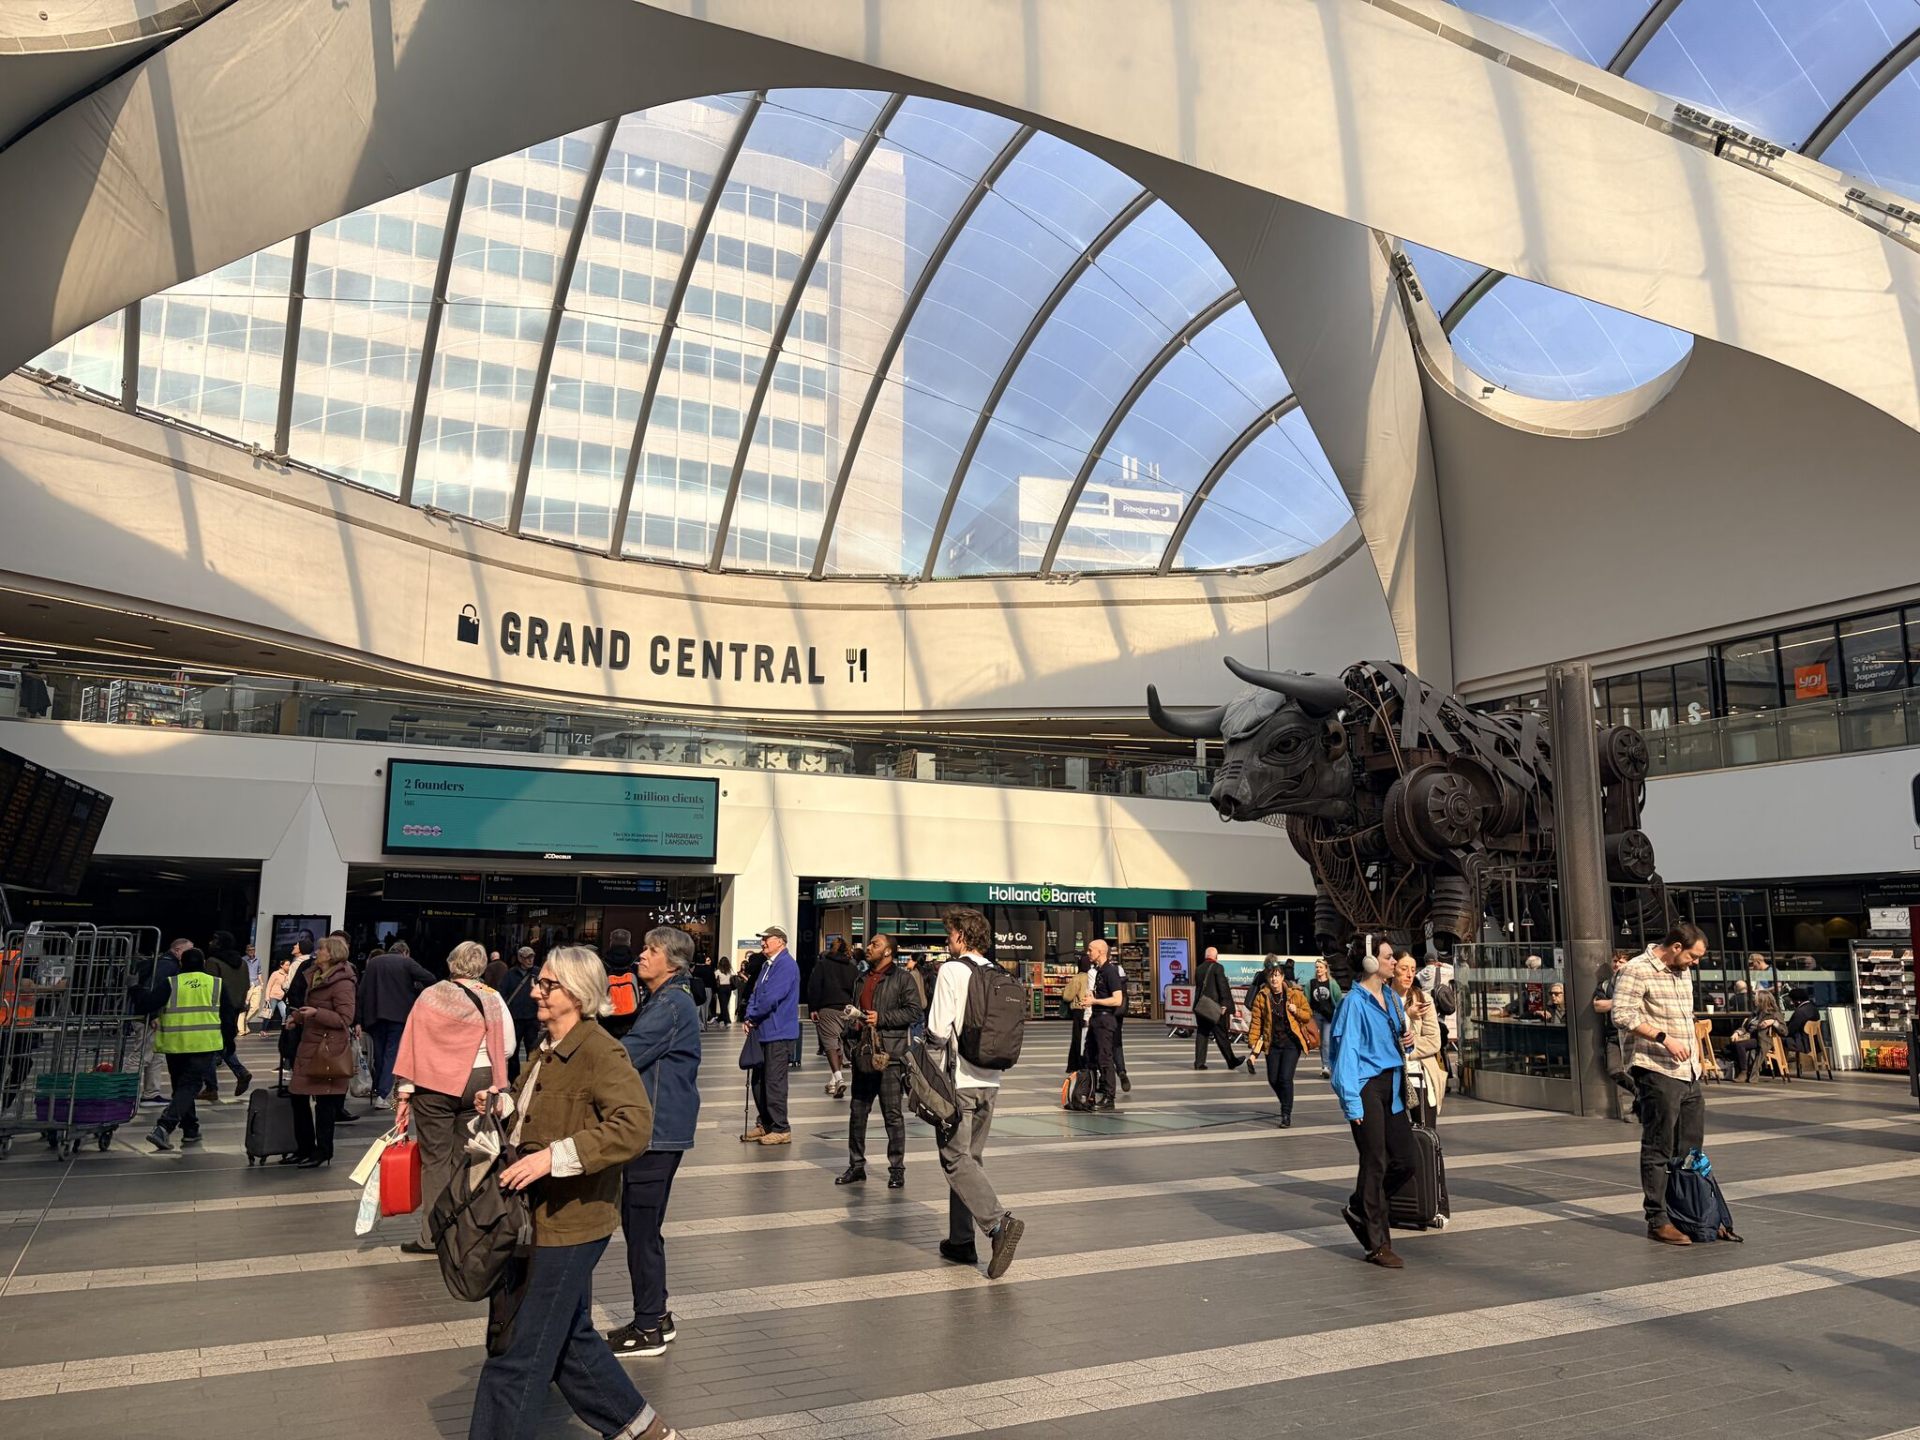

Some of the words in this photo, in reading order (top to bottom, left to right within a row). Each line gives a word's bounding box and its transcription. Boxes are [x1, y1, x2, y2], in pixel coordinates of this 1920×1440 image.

[500, 610, 631, 671] GRAND
[650, 635, 825, 685] CENTRAL
[1852, 654, 1877, 664] Sushi
[1861, 663, 1885, 672] fresh
[1855, 669, 1896, 681] Japanese
[1855, 680, 1876, 690] food
[404, 778, 411, 789] 2
[414, 778, 465, 792] founders
[624, 791, 631, 801] 2
[633, 791, 669, 802] million
[672, 793, 704, 804] clients
[665, 832, 704, 840] HARGREAVES
[816, 884, 861, 899] Holland&Barrett
[989, 886, 1096, 904] Holland&Barrett
[1269, 915, 1280, 929] 4
[1015, 932, 1027, 941] Go
